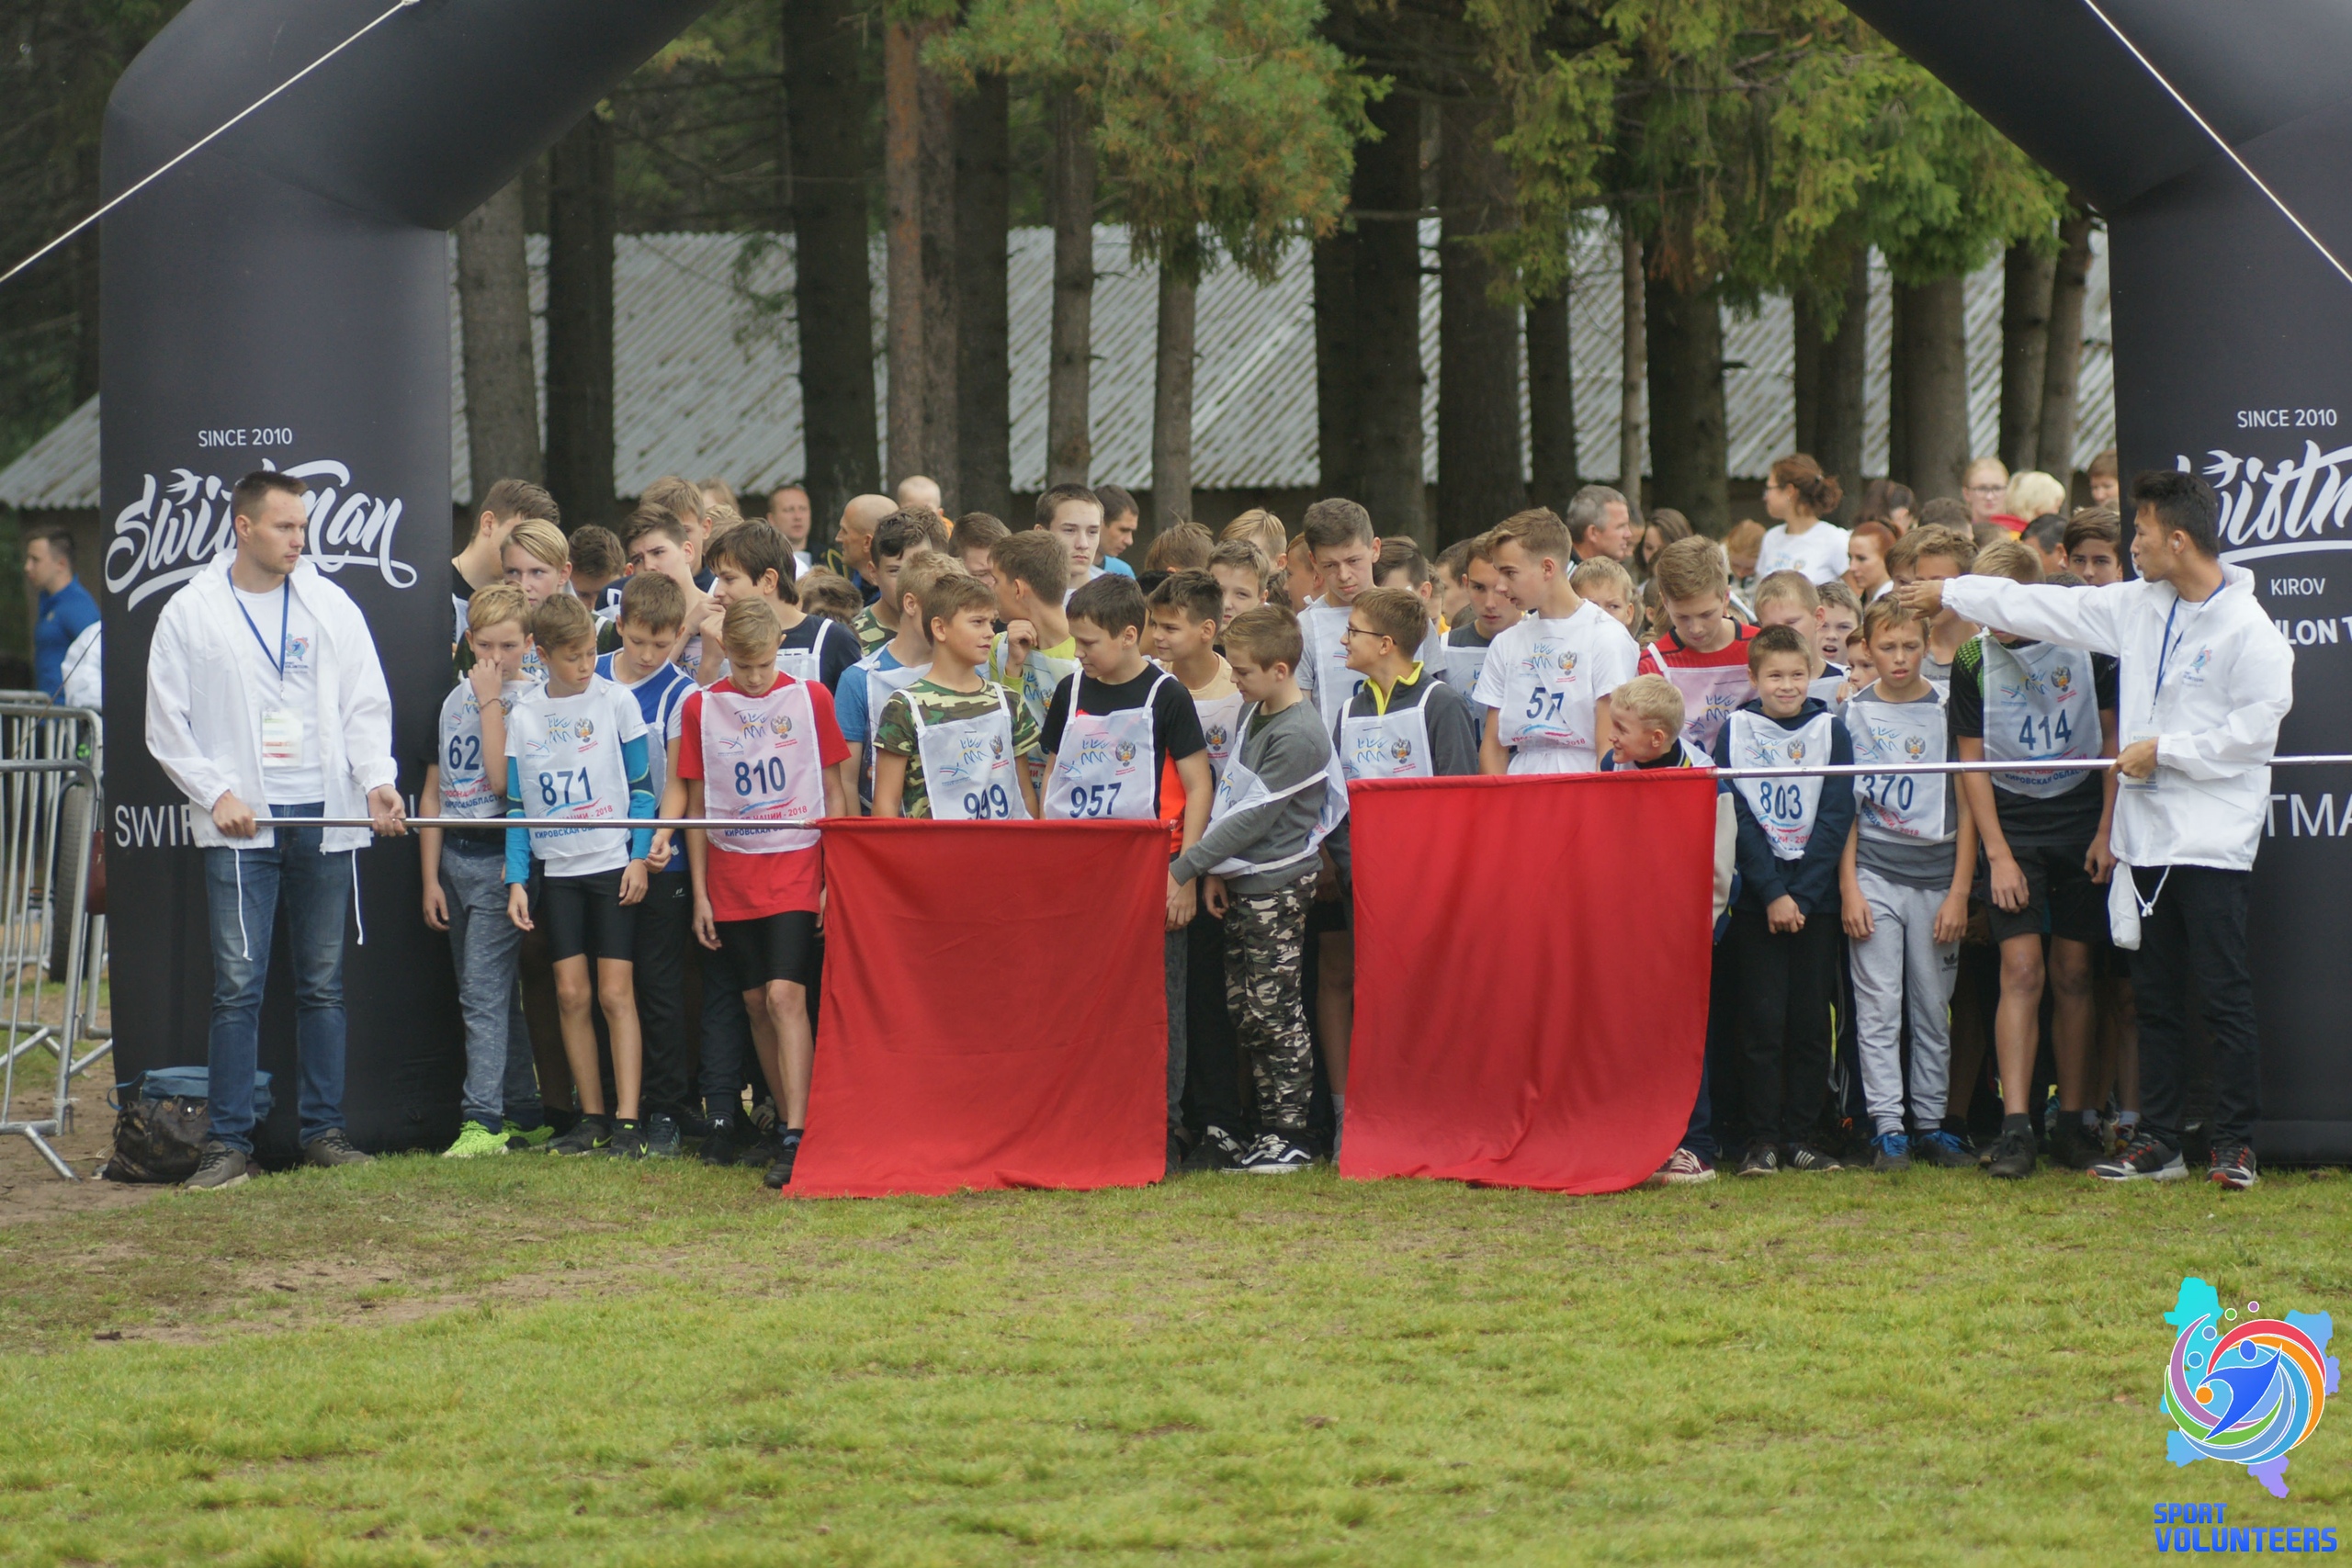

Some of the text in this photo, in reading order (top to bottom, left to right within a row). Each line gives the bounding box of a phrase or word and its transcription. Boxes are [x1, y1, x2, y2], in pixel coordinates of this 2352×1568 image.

[2237, 408, 2338, 429] SINCE 2010
[198, 427, 293, 448] SINCE 2010
[2270, 577, 2326, 596] KIROV
[2018, 708, 2073, 750] 414
[538, 766, 593, 807] 871
[734, 756, 786, 796] 810
[1862, 774, 1914, 811] 370
[595, 805, 613, 818] 2018
[788, 805, 808, 817] 2018
[1069, 781, 1123, 818] 957
[1759, 781, 1803, 819] 803
